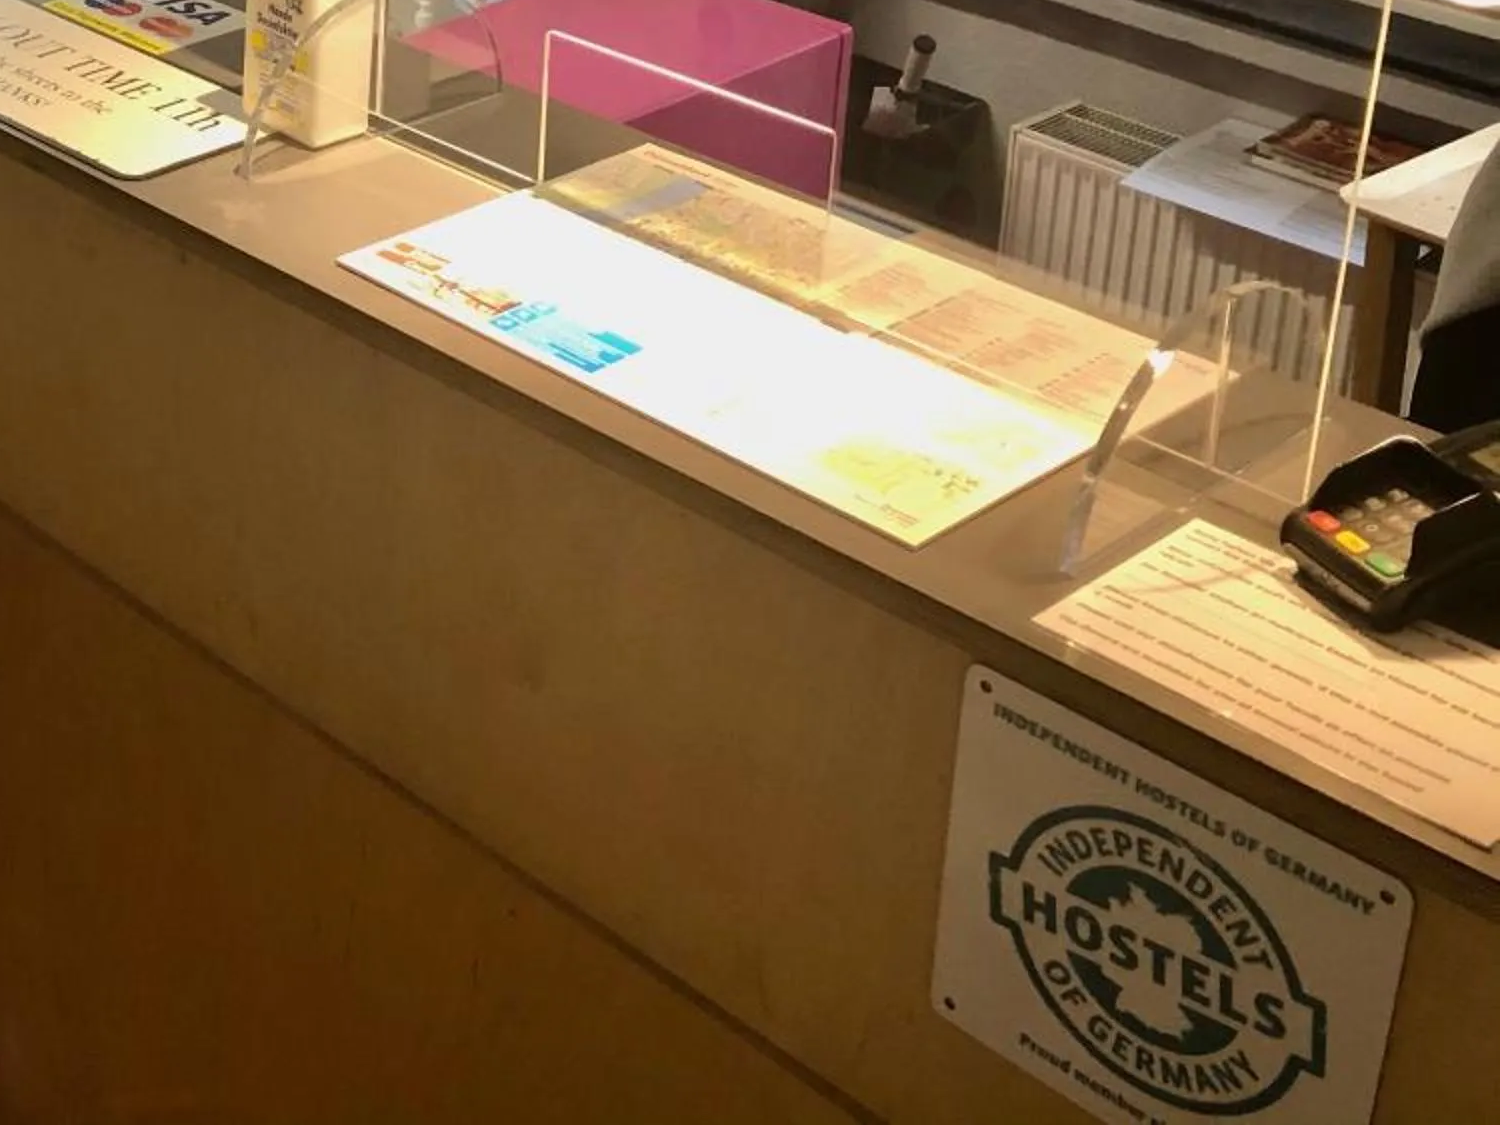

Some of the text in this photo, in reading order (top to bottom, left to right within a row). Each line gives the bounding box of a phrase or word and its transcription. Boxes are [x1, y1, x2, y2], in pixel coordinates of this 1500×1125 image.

[66, 54, 162, 102] TIME
[993, 702, 1377, 917] INDEPENDENT HOSTELS OF GERMANY
[1020, 881, 1287, 1041] HOSTELS
[1037, 825, 1275, 971] INDEPENDENT
[1017, 1032, 1146, 1125] Proud member
[1042, 958, 1263, 1097] OF GERMANY
